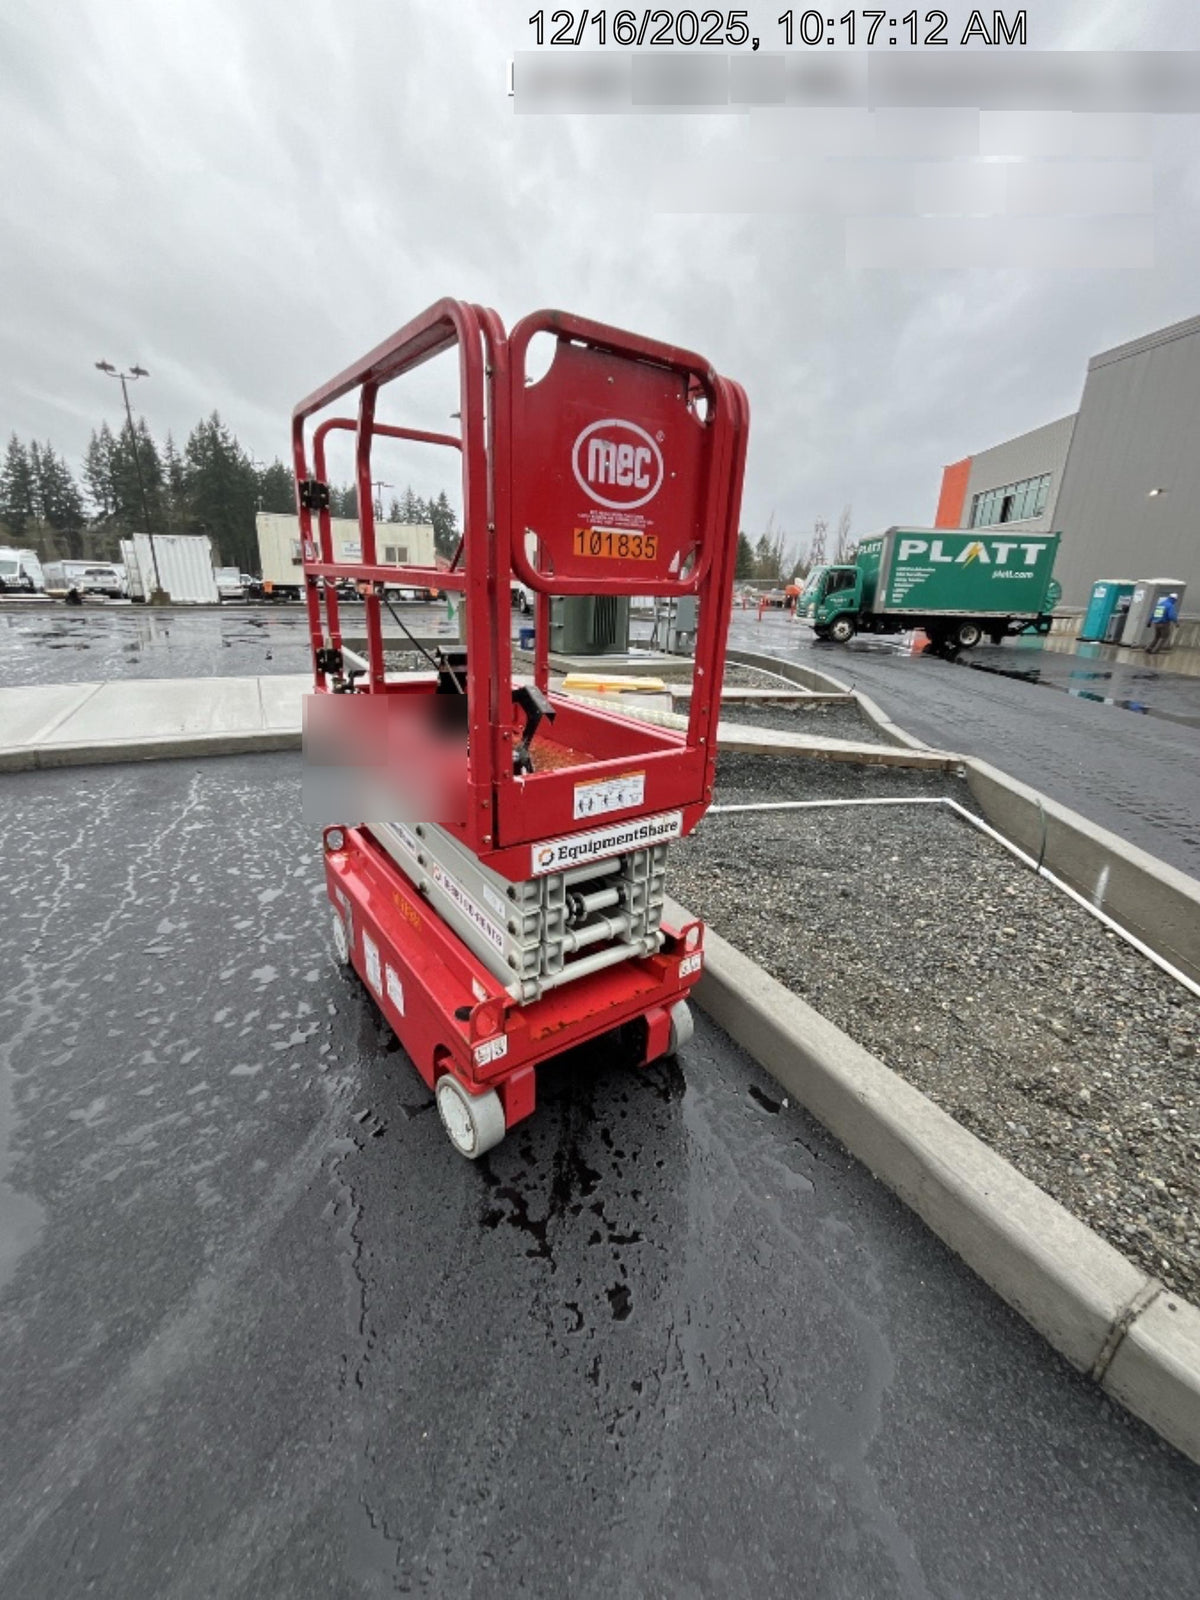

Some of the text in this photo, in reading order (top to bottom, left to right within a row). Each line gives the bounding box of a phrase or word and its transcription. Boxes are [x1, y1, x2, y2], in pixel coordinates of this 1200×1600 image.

[576, 530, 656, 559] 101835
[897, 539, 1047, 565] PLATT
[992, 569, 1034, 579] platt.com
[557, 819, 678, 861] EquipmentShare
